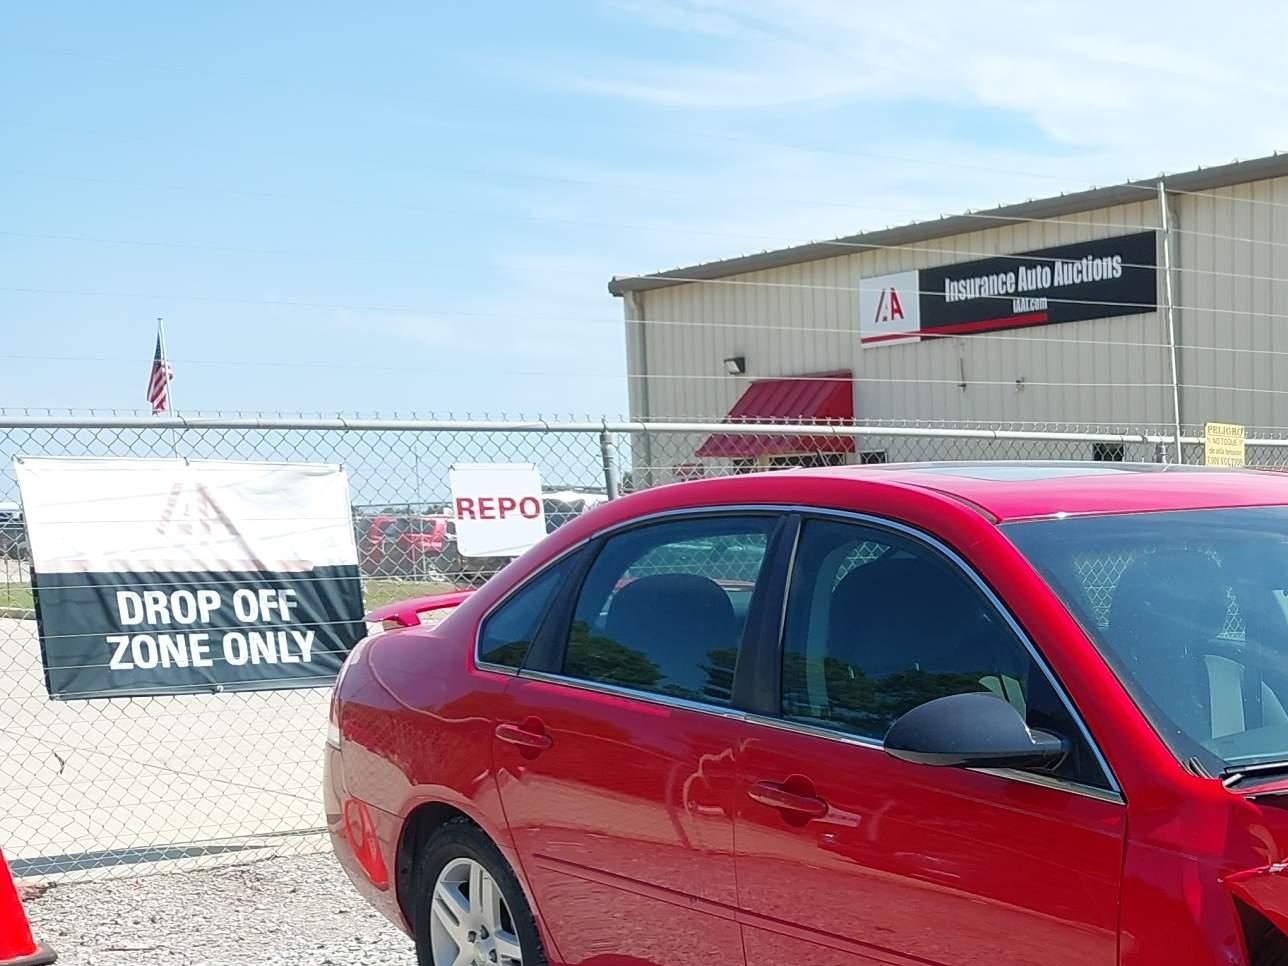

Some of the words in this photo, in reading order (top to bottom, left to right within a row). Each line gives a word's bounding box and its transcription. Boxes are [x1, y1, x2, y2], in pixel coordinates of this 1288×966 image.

[944, 270, 1016, 303] Insurance
[1017, 264, 1051, 292] Auto
[1053, 254, 1123, 287] Auctions
[1207, 425, 1244, 436] PELIGRO
[455, 496, 541, 520] REPO
[116, 589, 222, 626] DROP
[232, 588, 298, 624] OFF
[106, 632, 214, 670] ZONE
[222, 630, 316, 666] ONLY
